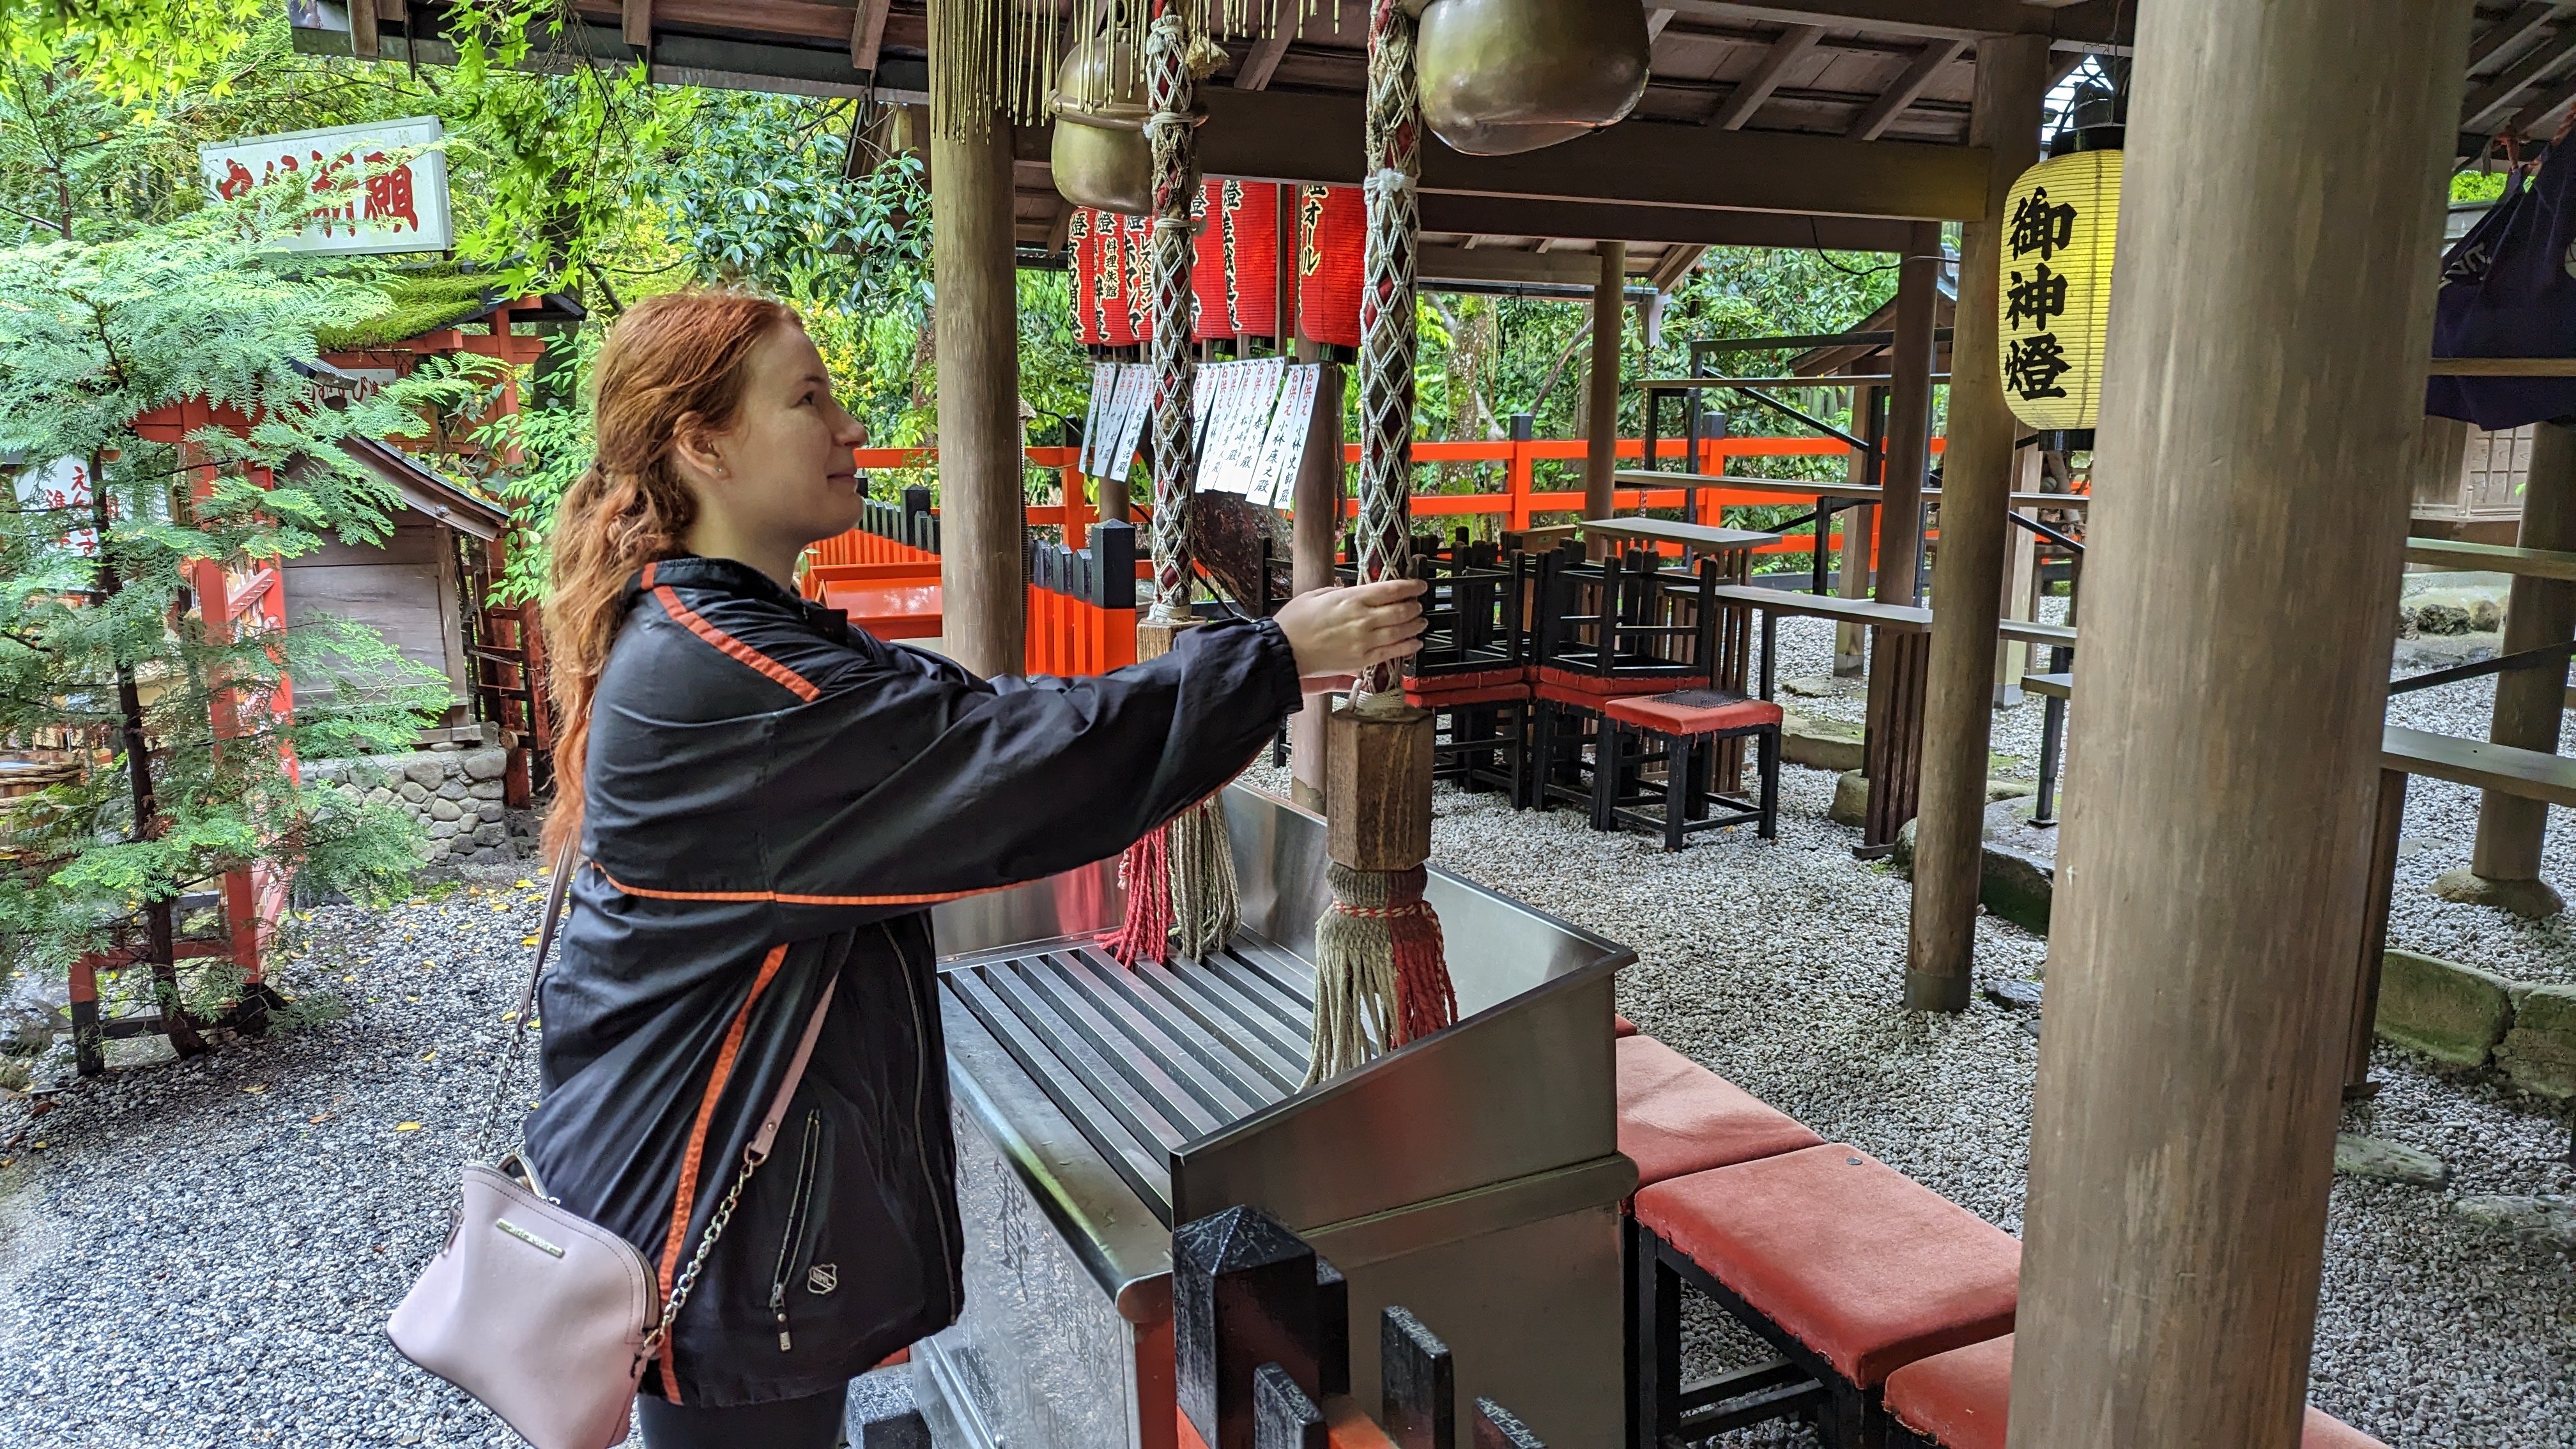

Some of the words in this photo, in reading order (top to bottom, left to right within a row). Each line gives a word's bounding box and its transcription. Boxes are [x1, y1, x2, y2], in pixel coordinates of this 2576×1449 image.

[1105, 238, 1117, 298] 料理旅館
[1302, 201, 1321, 275] オール
[1140, 235, 1153, 314] レストラン
[2005, 185, 2077, 401] 御神燈
[1284, 369, 1299, 416] お供え
[1301, 368, 1315, 416] お供え
